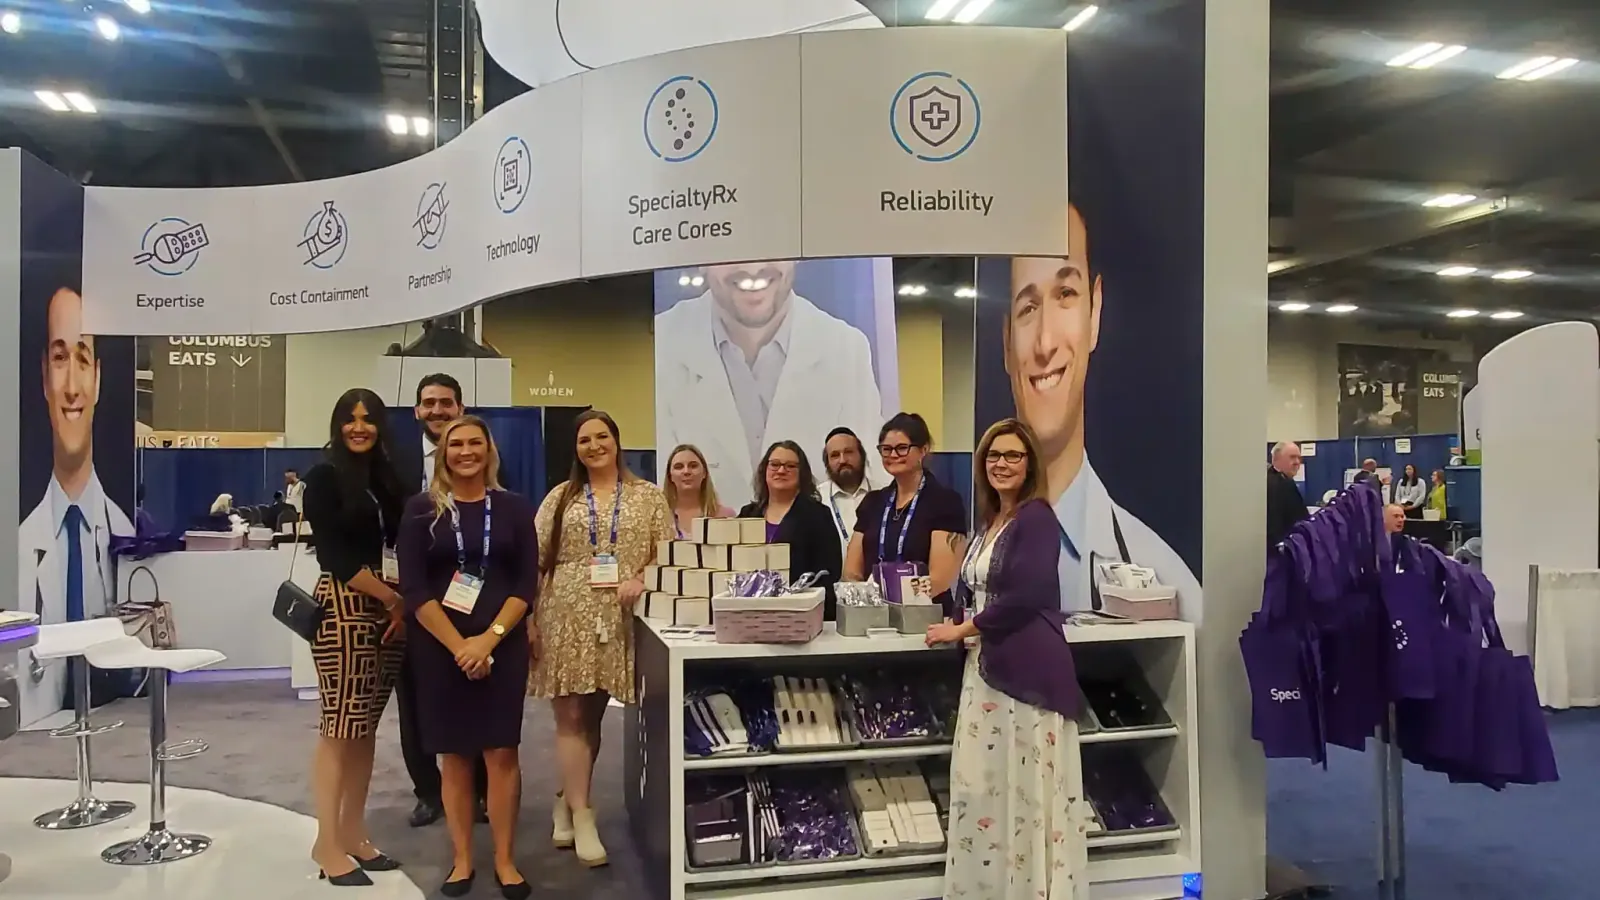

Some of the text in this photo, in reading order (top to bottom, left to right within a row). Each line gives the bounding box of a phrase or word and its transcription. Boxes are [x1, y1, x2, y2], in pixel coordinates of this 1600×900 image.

[628, 184, 738, 216] SpecialtyRx
[880, 189, 994, 216] Reliability
[632, 219, 733, 246] Care Cores
[486, 233, 541, 262] Technology
[408, 264, 452, 291] Partnership
[136, 293, 205, 311] Expertise
[270, 285, 369, 306] Cost Containment
[169, 335, 272, 348] COLUMBUS
[169, 351, 217, 366] EATS
[529, 387, 574, 397] WOMEN
[1423, 387, 1445, 398] EATS
